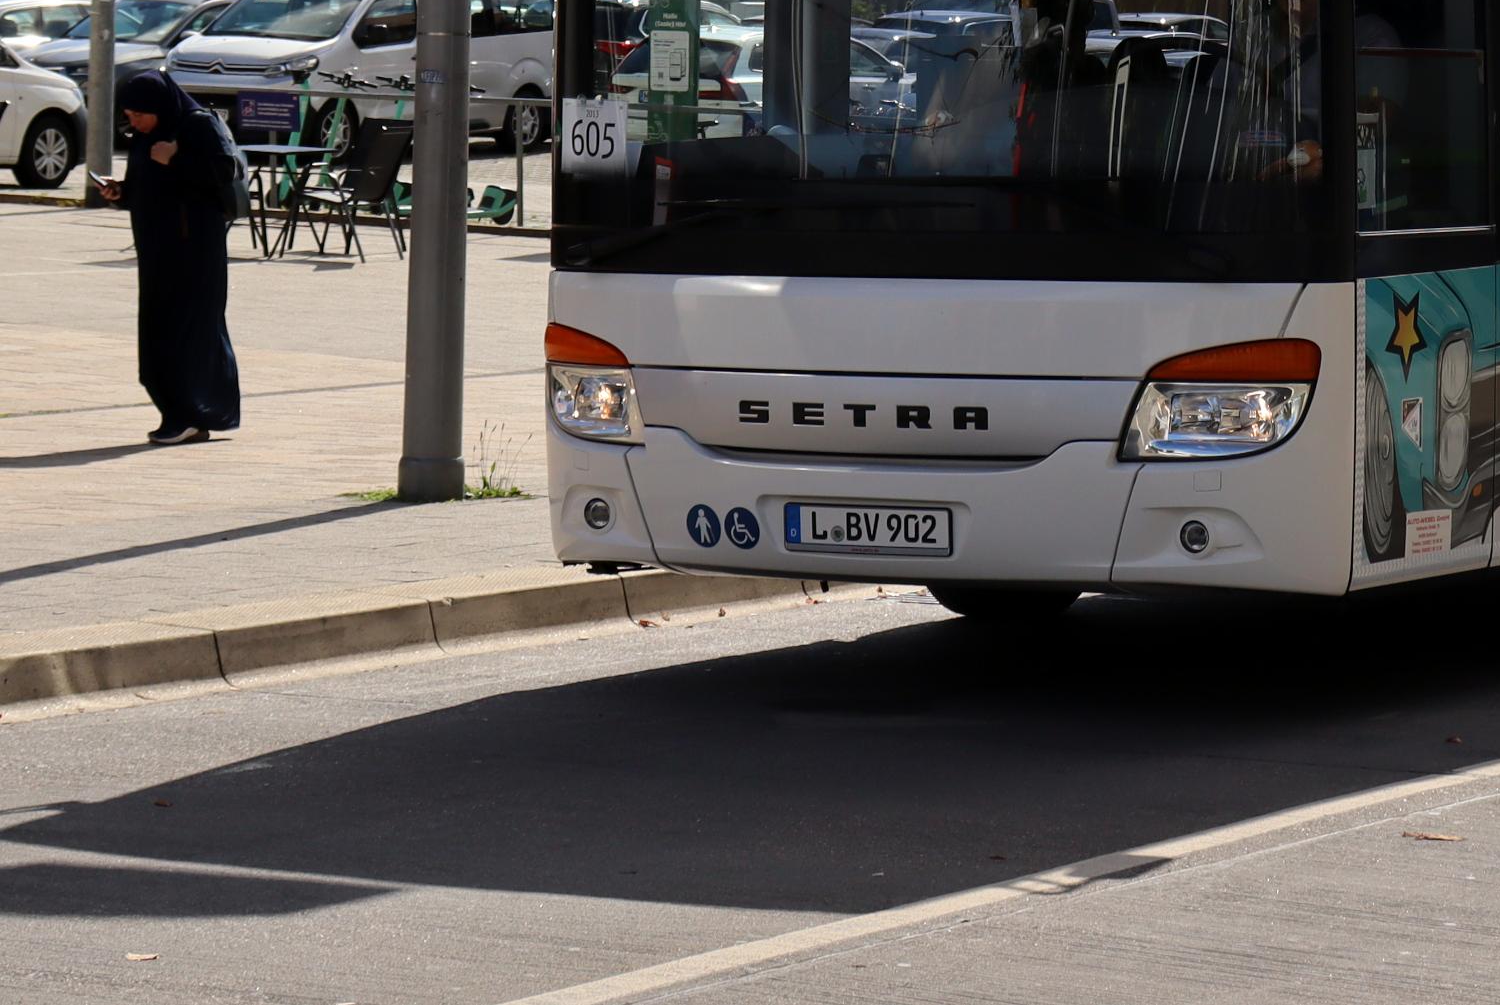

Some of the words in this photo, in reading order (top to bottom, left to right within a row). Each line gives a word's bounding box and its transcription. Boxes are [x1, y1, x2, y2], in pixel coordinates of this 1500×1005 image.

[571, 119, 616, 159] 605
[739, 400, 989, 430] SETRA
[811, 511, 828, 541] L
[845, 511, 880, 542] BV
[886, 513, 937, 544] 902
